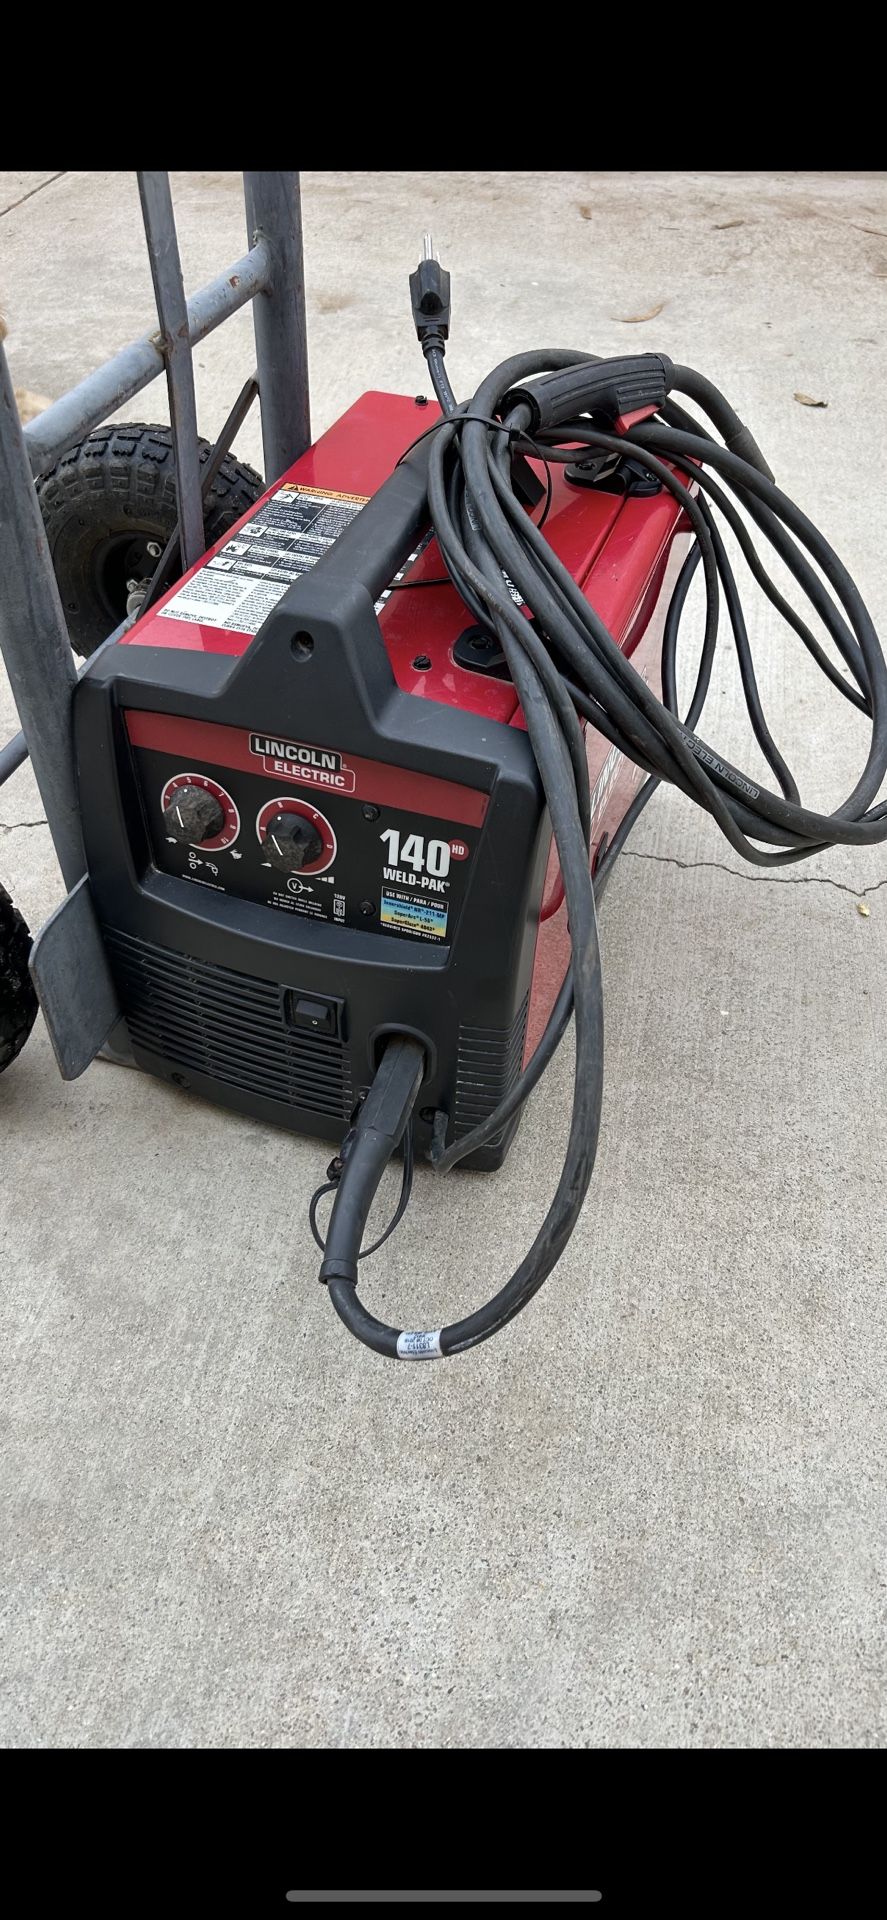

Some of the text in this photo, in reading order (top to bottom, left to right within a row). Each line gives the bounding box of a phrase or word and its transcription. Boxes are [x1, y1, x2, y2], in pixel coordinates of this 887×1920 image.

[300, 487, 333, 496] WARNING
[255, 738, 336, 770] LINCOLN
[186, 776, 192, 784] 5
[274, 760, 345, 787] ELECTRIC
[714, 762, 760, 798] LINCOLN
[380, 828, 465, 878] 140 HD
[385, 890, 395, 898] USE
[396, 893, 410, 901] WITH
[413, 897, 427, 906] PARA
[430, 901, 444, 910] POUR
